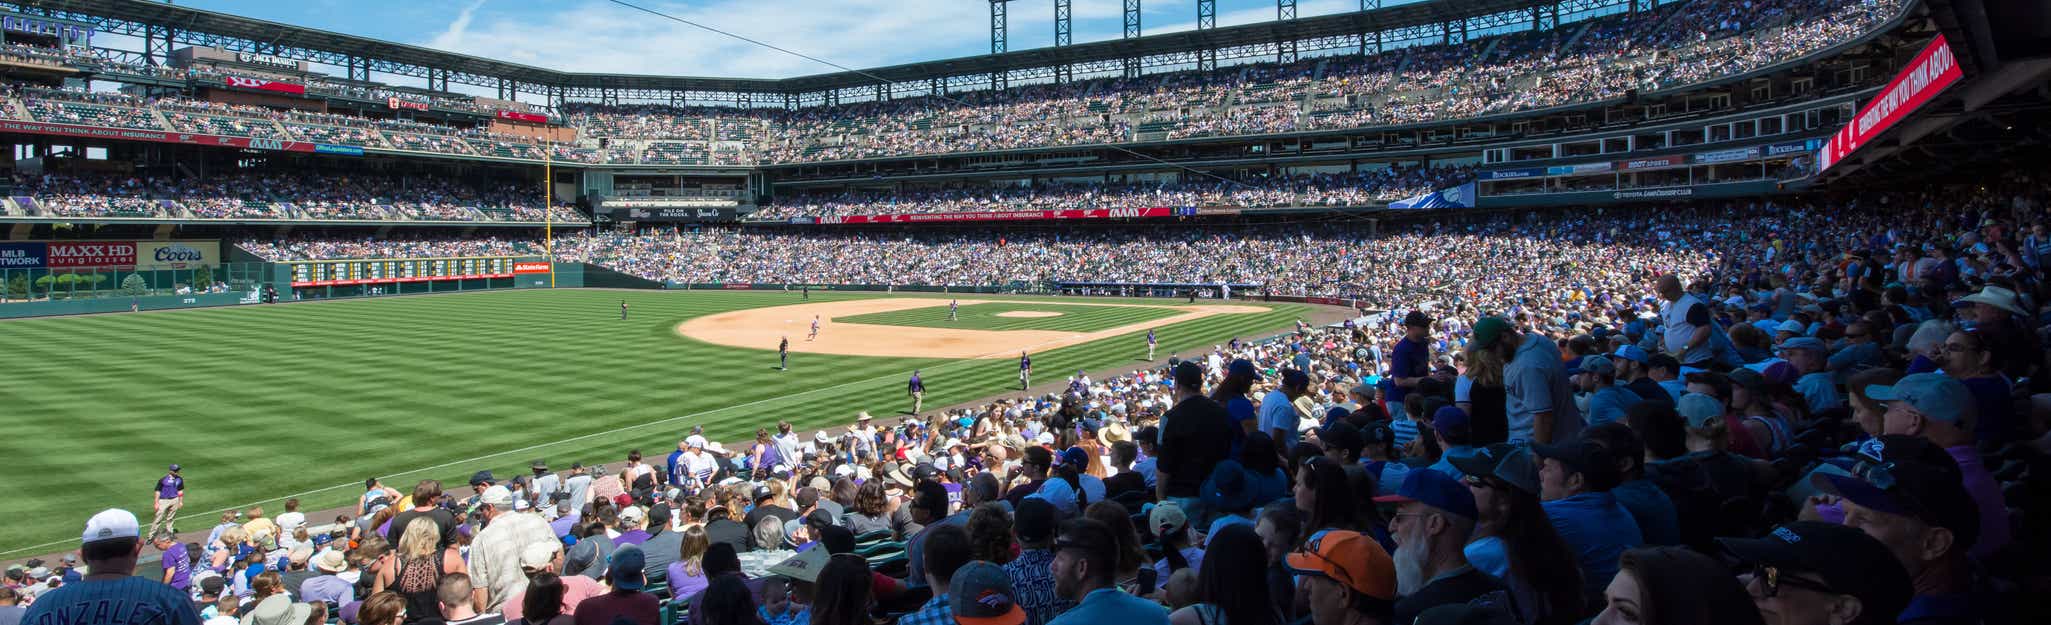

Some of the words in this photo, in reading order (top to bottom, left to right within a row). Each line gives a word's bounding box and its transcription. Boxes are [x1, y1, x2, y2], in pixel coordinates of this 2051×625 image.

[1880, 95, 1889, 119] THE
[1888, 87, 1899, 113] WAY
[1899, 75, 1910, 106] YOU
[1909, 59, 1929, 97] THINK
[24, 124, 42, 132] WAY
[45, 125, 62, 133] YOU
[64, 127, 89, 135] THINK
[91, 129, 118, 137] ABOUT
[121, 131, 167, 140] INSURANCE
[1, 249, 26, 257] MLB
[50, 246, 105, 257] MAXX
[108, 245, 134, 257] HD
[154, 246, 203, 262] Coors
[50, 257, 133, 265] sunglasses
